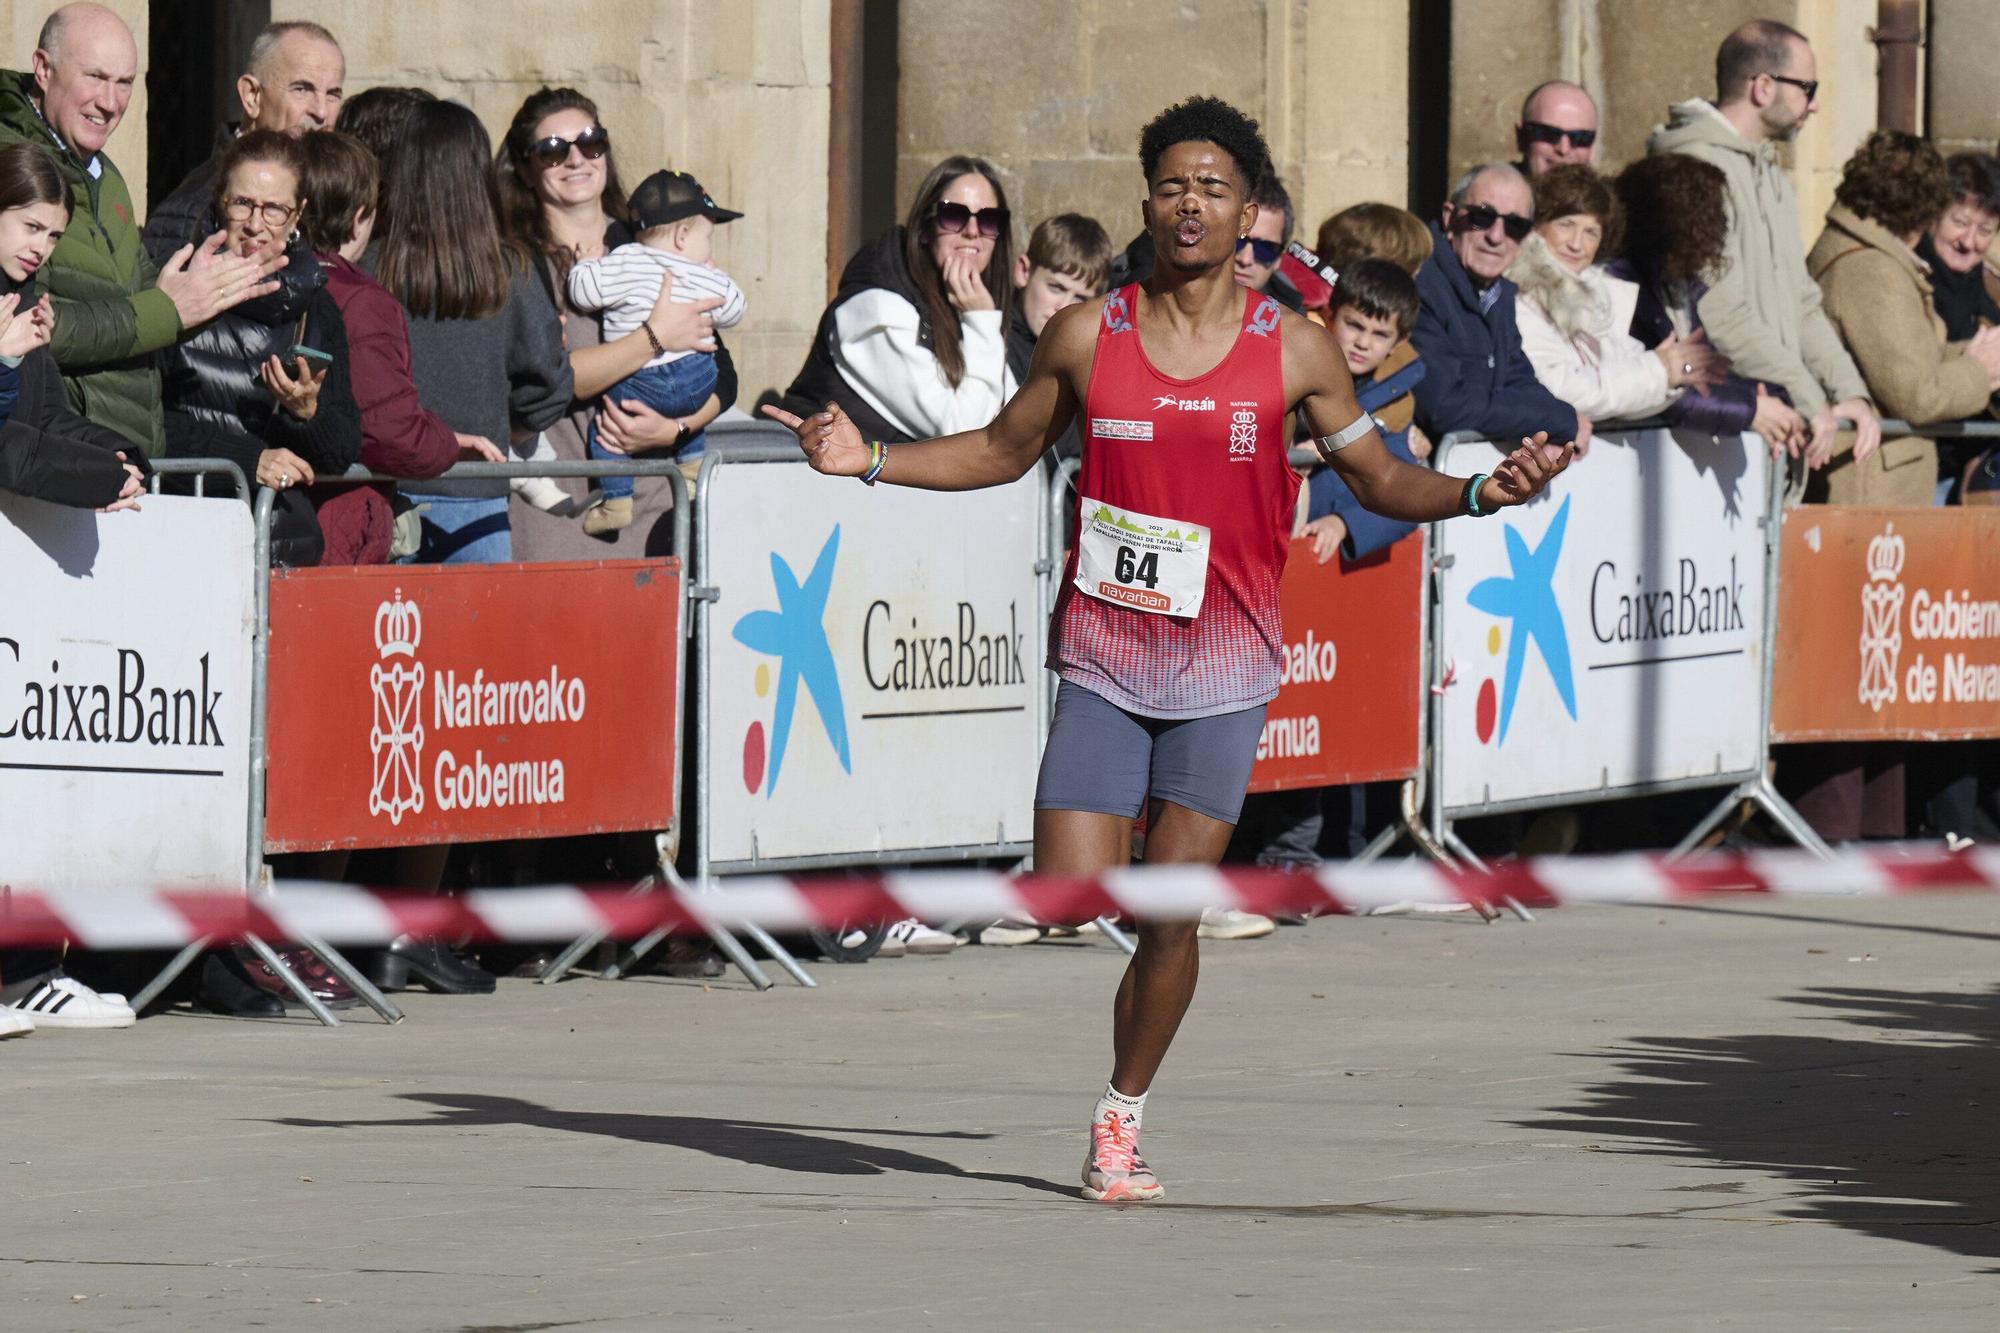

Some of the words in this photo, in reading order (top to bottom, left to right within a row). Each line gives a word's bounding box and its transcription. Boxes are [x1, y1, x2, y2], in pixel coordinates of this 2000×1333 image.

[1179, 397, 1215, 411] rasán
[1109, 525, 1124, 536] CROSS
[1125, 531, 1144, 541] PEÑAS
[1142, 543, 1161, 551] HERRI
[1115, 546, 1159, 590] 64
[1102, 584, 1167, 608] navarban
[1590, 552, 1744, 643] CaixaBank
[863, 599, 1025, 692] CaixaBank
[1280, 629, 1337, 686] oako
[434, 664, 586, 731] Nafarroako
[1905, 652, 1937, 703] de
[1943, 652, 2000, 703] Nava
[1256, 715, 1320, 761] ernua
[434, 749, 565, 811] Gobernua
